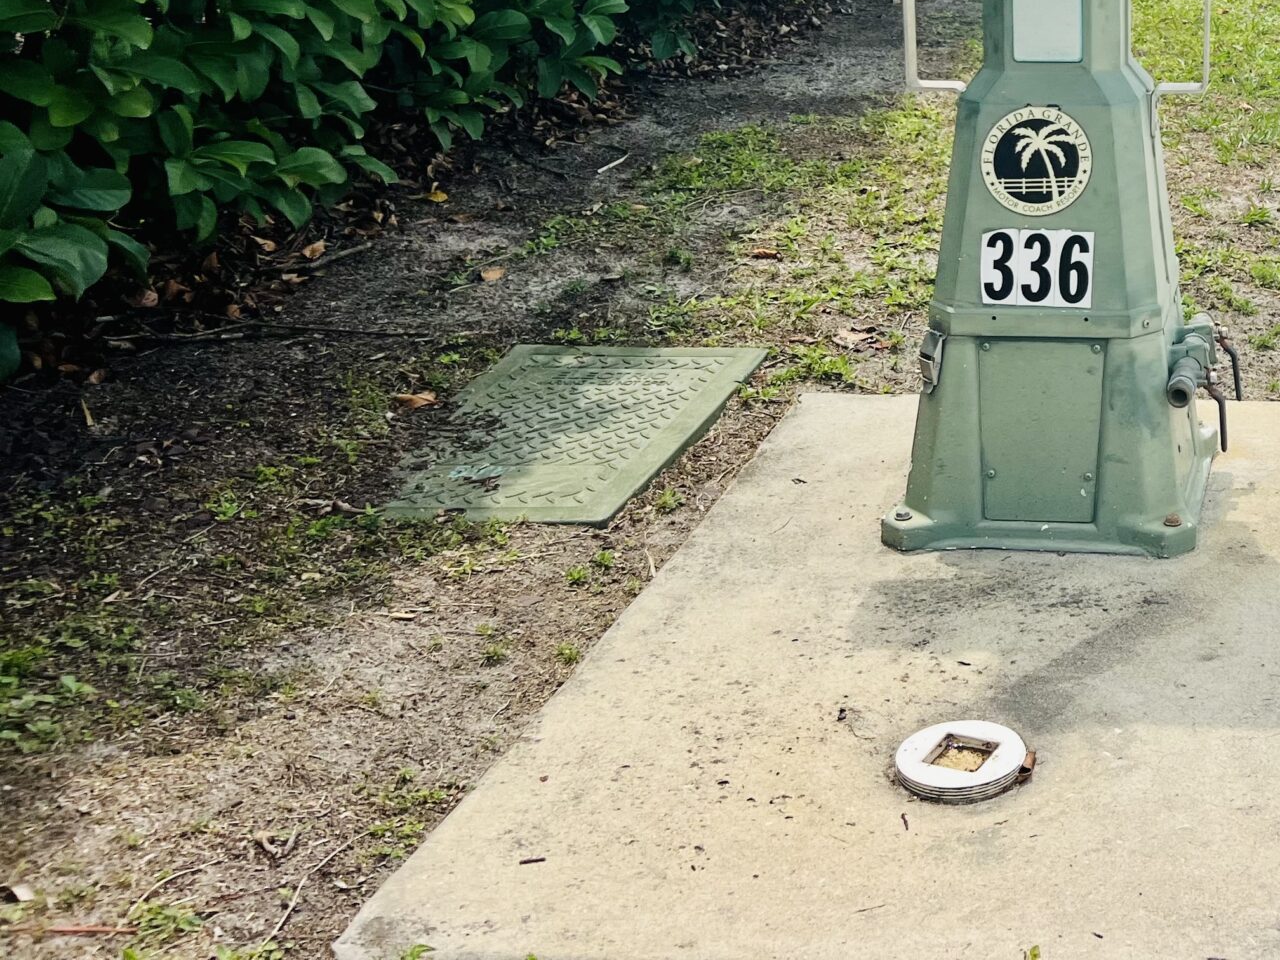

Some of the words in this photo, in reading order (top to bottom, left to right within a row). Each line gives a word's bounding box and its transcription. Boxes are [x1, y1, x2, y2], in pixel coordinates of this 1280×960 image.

[983, 109, 1036, 165] FLORIDA
[1042, 109, 1090, 163] GRANDE
[992, 186, 1019, 209] MOTOR
[1022, 204, 1053, 213] COACH
[1056, 185, 1081, 207] RESORT
[984, 232, 1090, 304] 336
